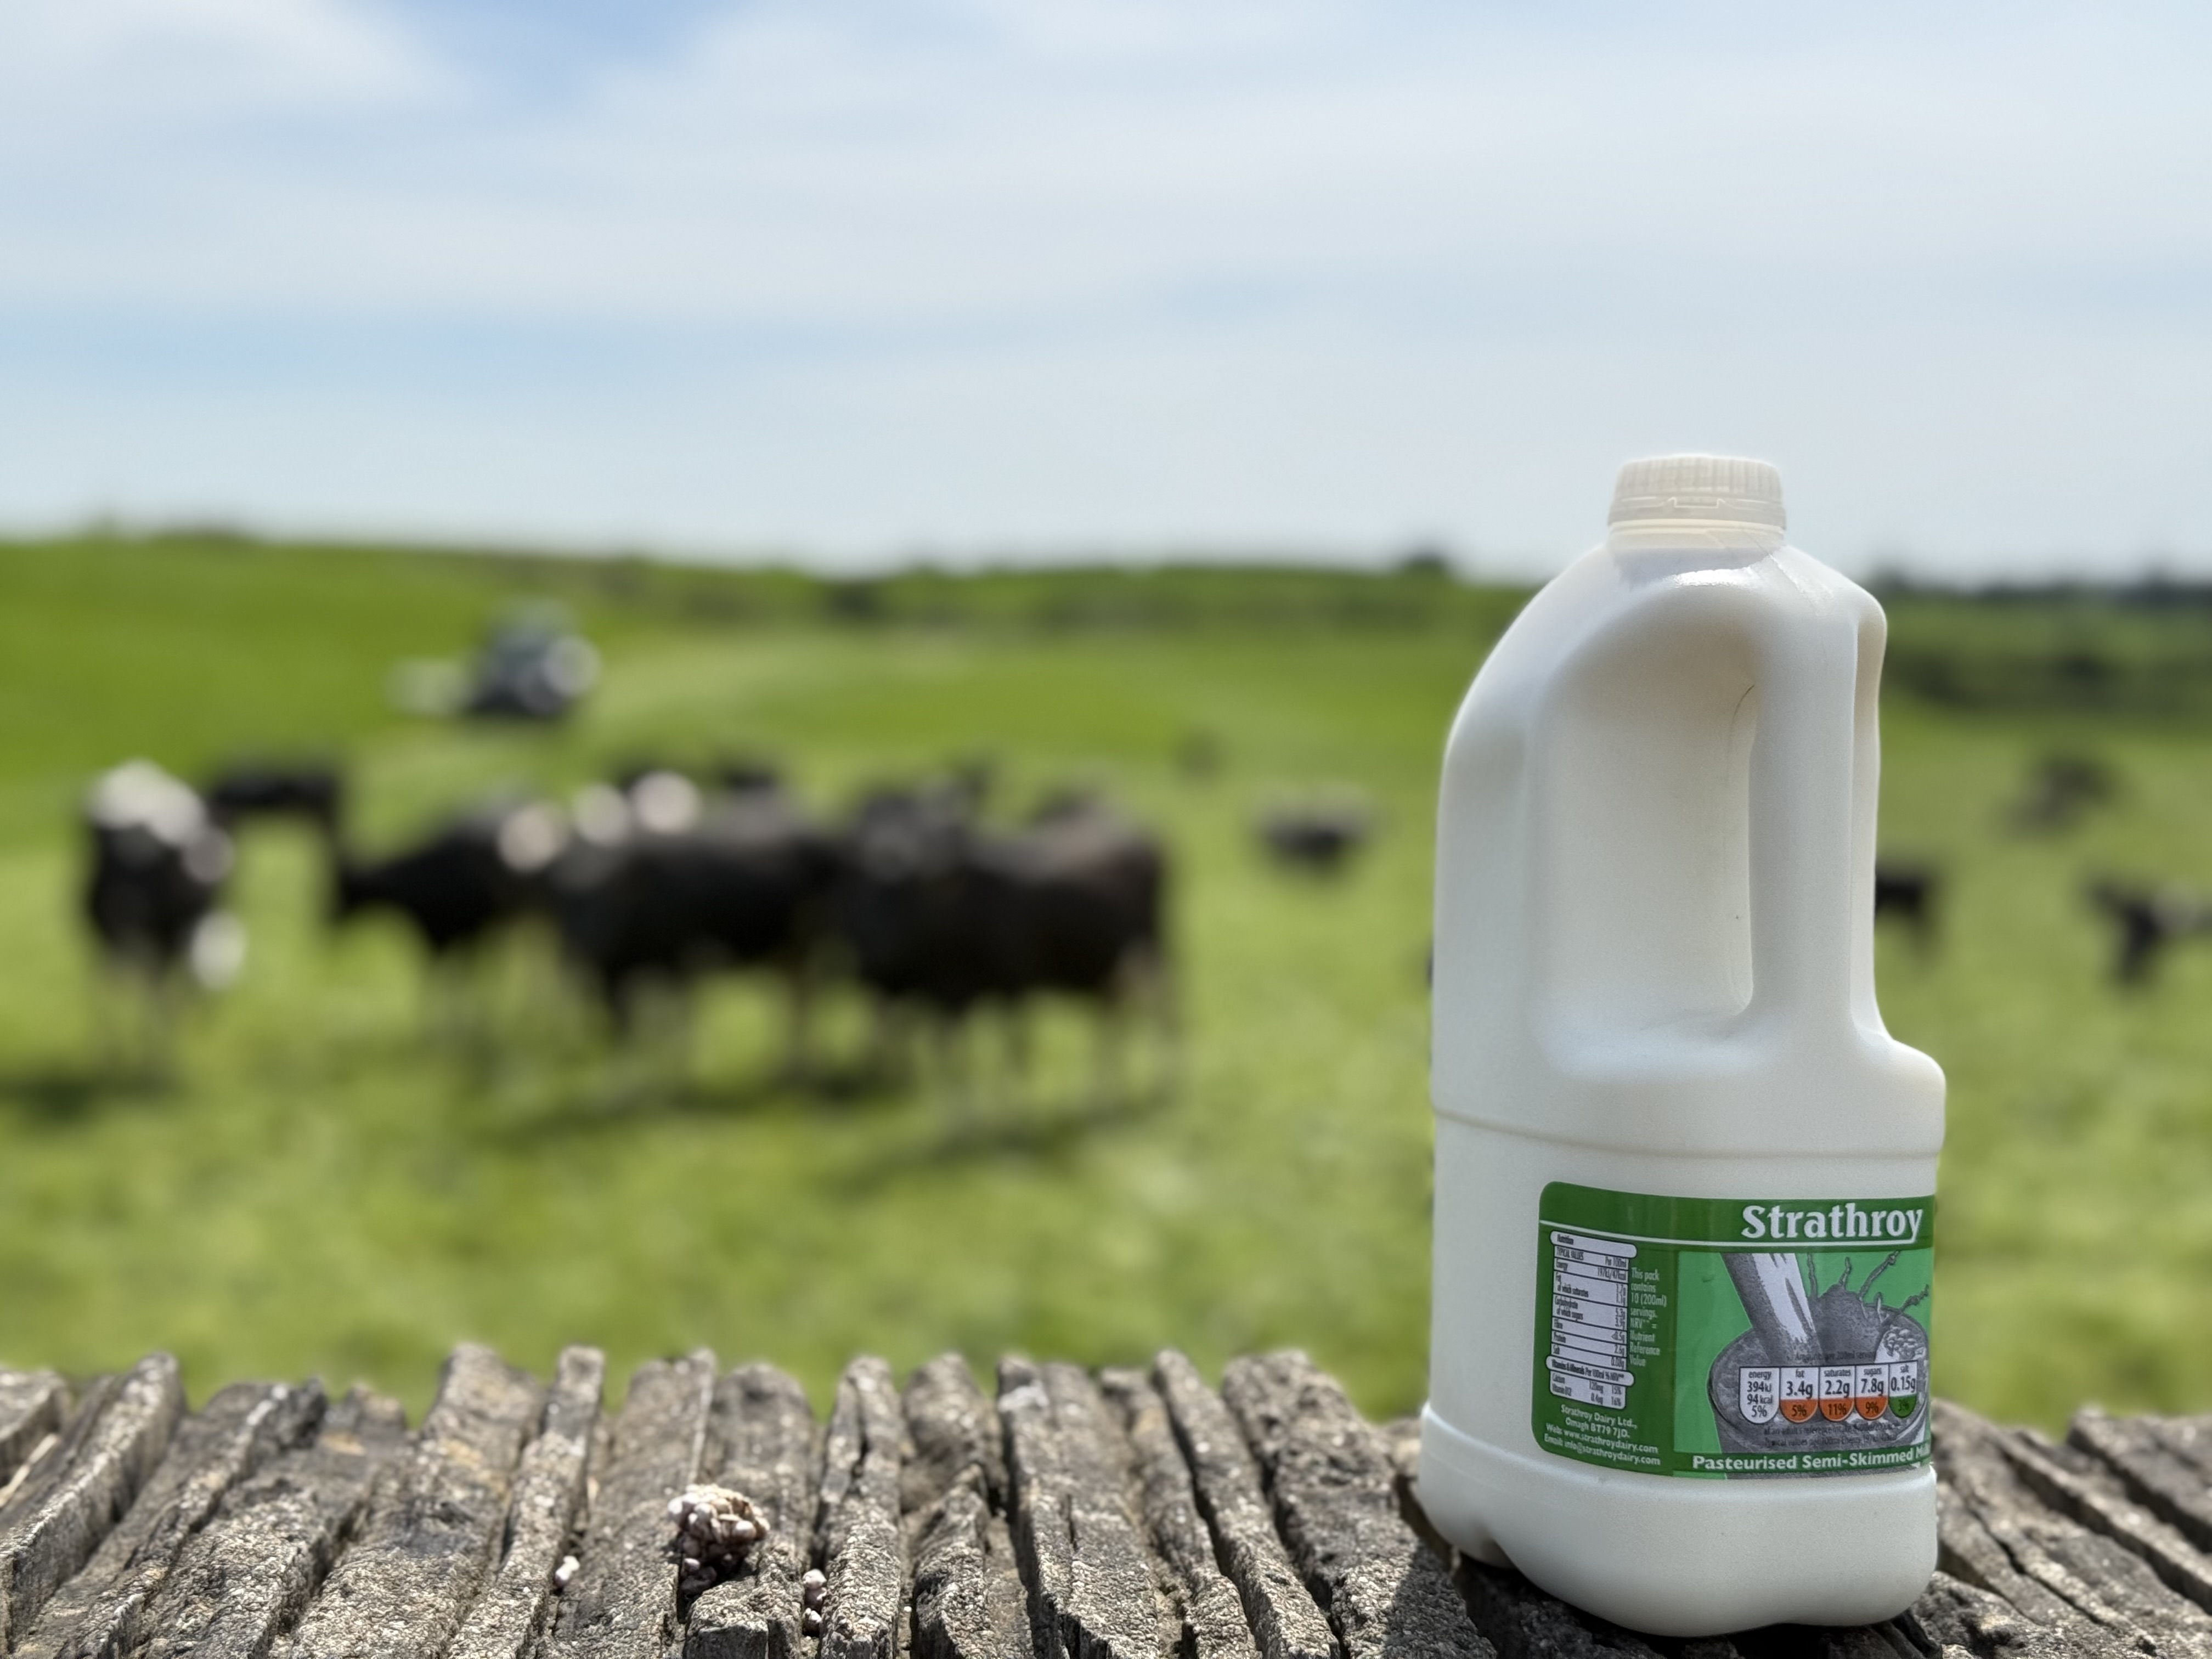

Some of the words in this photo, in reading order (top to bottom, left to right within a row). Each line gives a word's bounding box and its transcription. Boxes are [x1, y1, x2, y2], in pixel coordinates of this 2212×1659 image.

[1741, 1203, 1923, 1243] Strathroy
[1631, 1267, 1643, 1279] This
[1644, 1269, 1660, 1282] pack
[1631, 1282, 1656, 1293] contains
[1631, 1292, 1639, 1304] 10
[1641, 1293, 1667, 1307] (200ml)
[1630, 1330, 1655, 1342] Nutrient
[1629, 1341, 1660, 1356] Reference
[1629, 1355, 1646, 1367] Value
[1748, 1371, 1771, 1380] energy
[1795, 1369, 1804, 1378] fat
[1824, 1369, 1851, 1377] saturates
[1864, 1368, 1882, 1377] sugars
[1900, 1364, 1909, 1373] salt
[1786, 1380, 1813, 1399] 3.4g
[1825, 1380, 1850, 1398] 2.2g
[1860, 1378, 1884, 1396] 7.8g
[1891, 1375, 1916, 1393] 0.15g
[1751, 1405, 1767, 1418] 5%
[1791, 1404, 1807, 1417] 5%
[1827, 1403, 1847, 1415] 11%
[1865, 1402, 1879, 1414] 9%
[1898, 1399, 1909, 1412] 3%
[1561, 1404, 1593, 1421] Strathroy
[1594, 1412, 1616, 1426] Dairy
[1565, 1417, 1589, 1431] Omagh
[1590, 1423, 1611, 1434] BT79
[1613, 1427, 1630, 1438] 7JD.
[1564, 1429, 1658, 1454] www.strathroydairy.com
[1564, 1440, 1661, 1466] info@strathroydairy.com
[1692, 1455, 1797, 1470] Pasteurised
[1802, 1447, 1914, 1469] Semi-Skimmed
